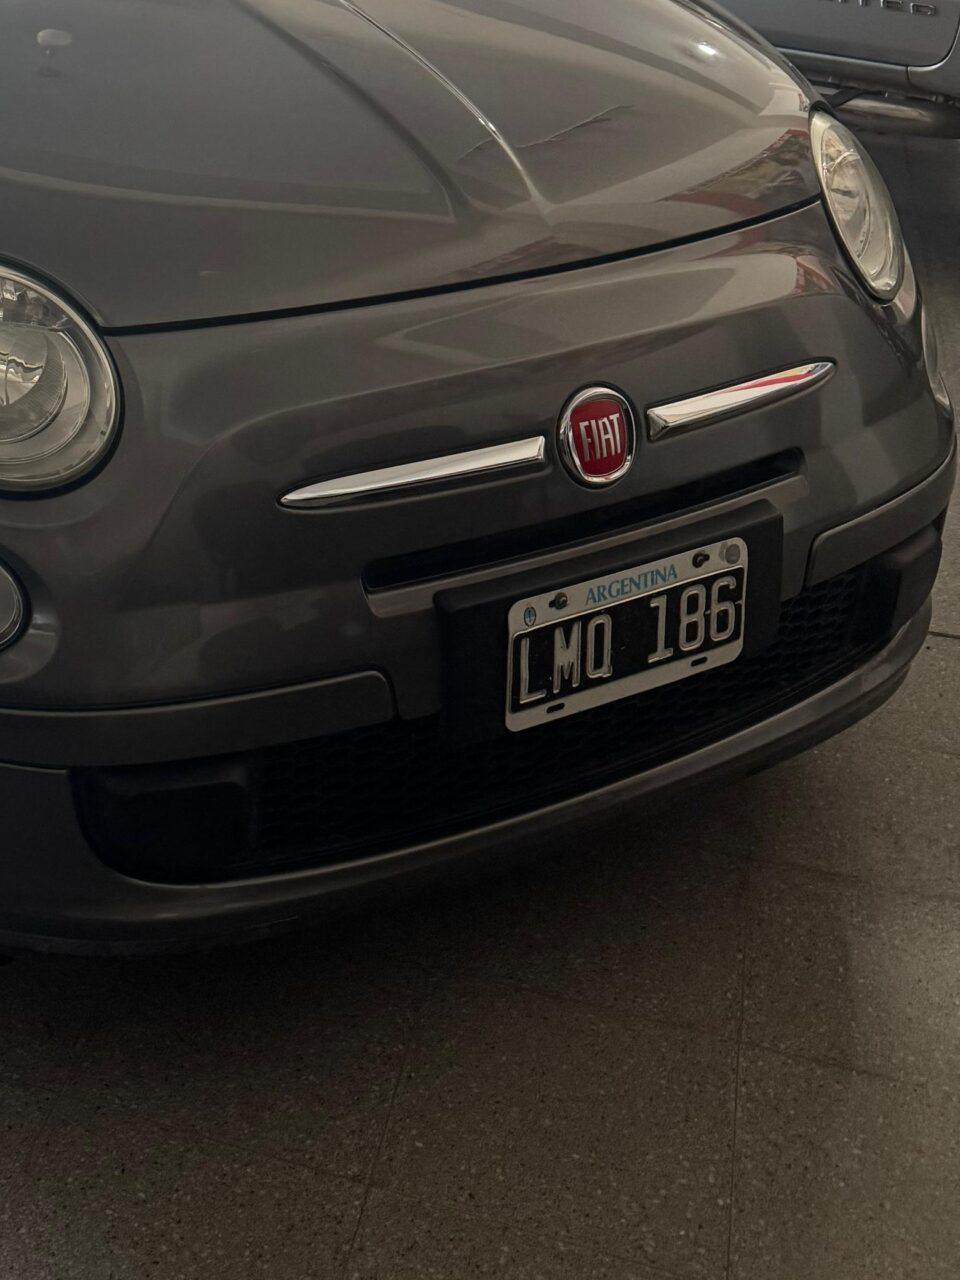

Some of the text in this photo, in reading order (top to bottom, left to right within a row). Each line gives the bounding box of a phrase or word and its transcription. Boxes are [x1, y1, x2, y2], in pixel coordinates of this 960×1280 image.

[579, 413, 621, 463] FIAT
[586, 564, 678, 605] ARGENTINA
[647, 575, 737, 663] 186
